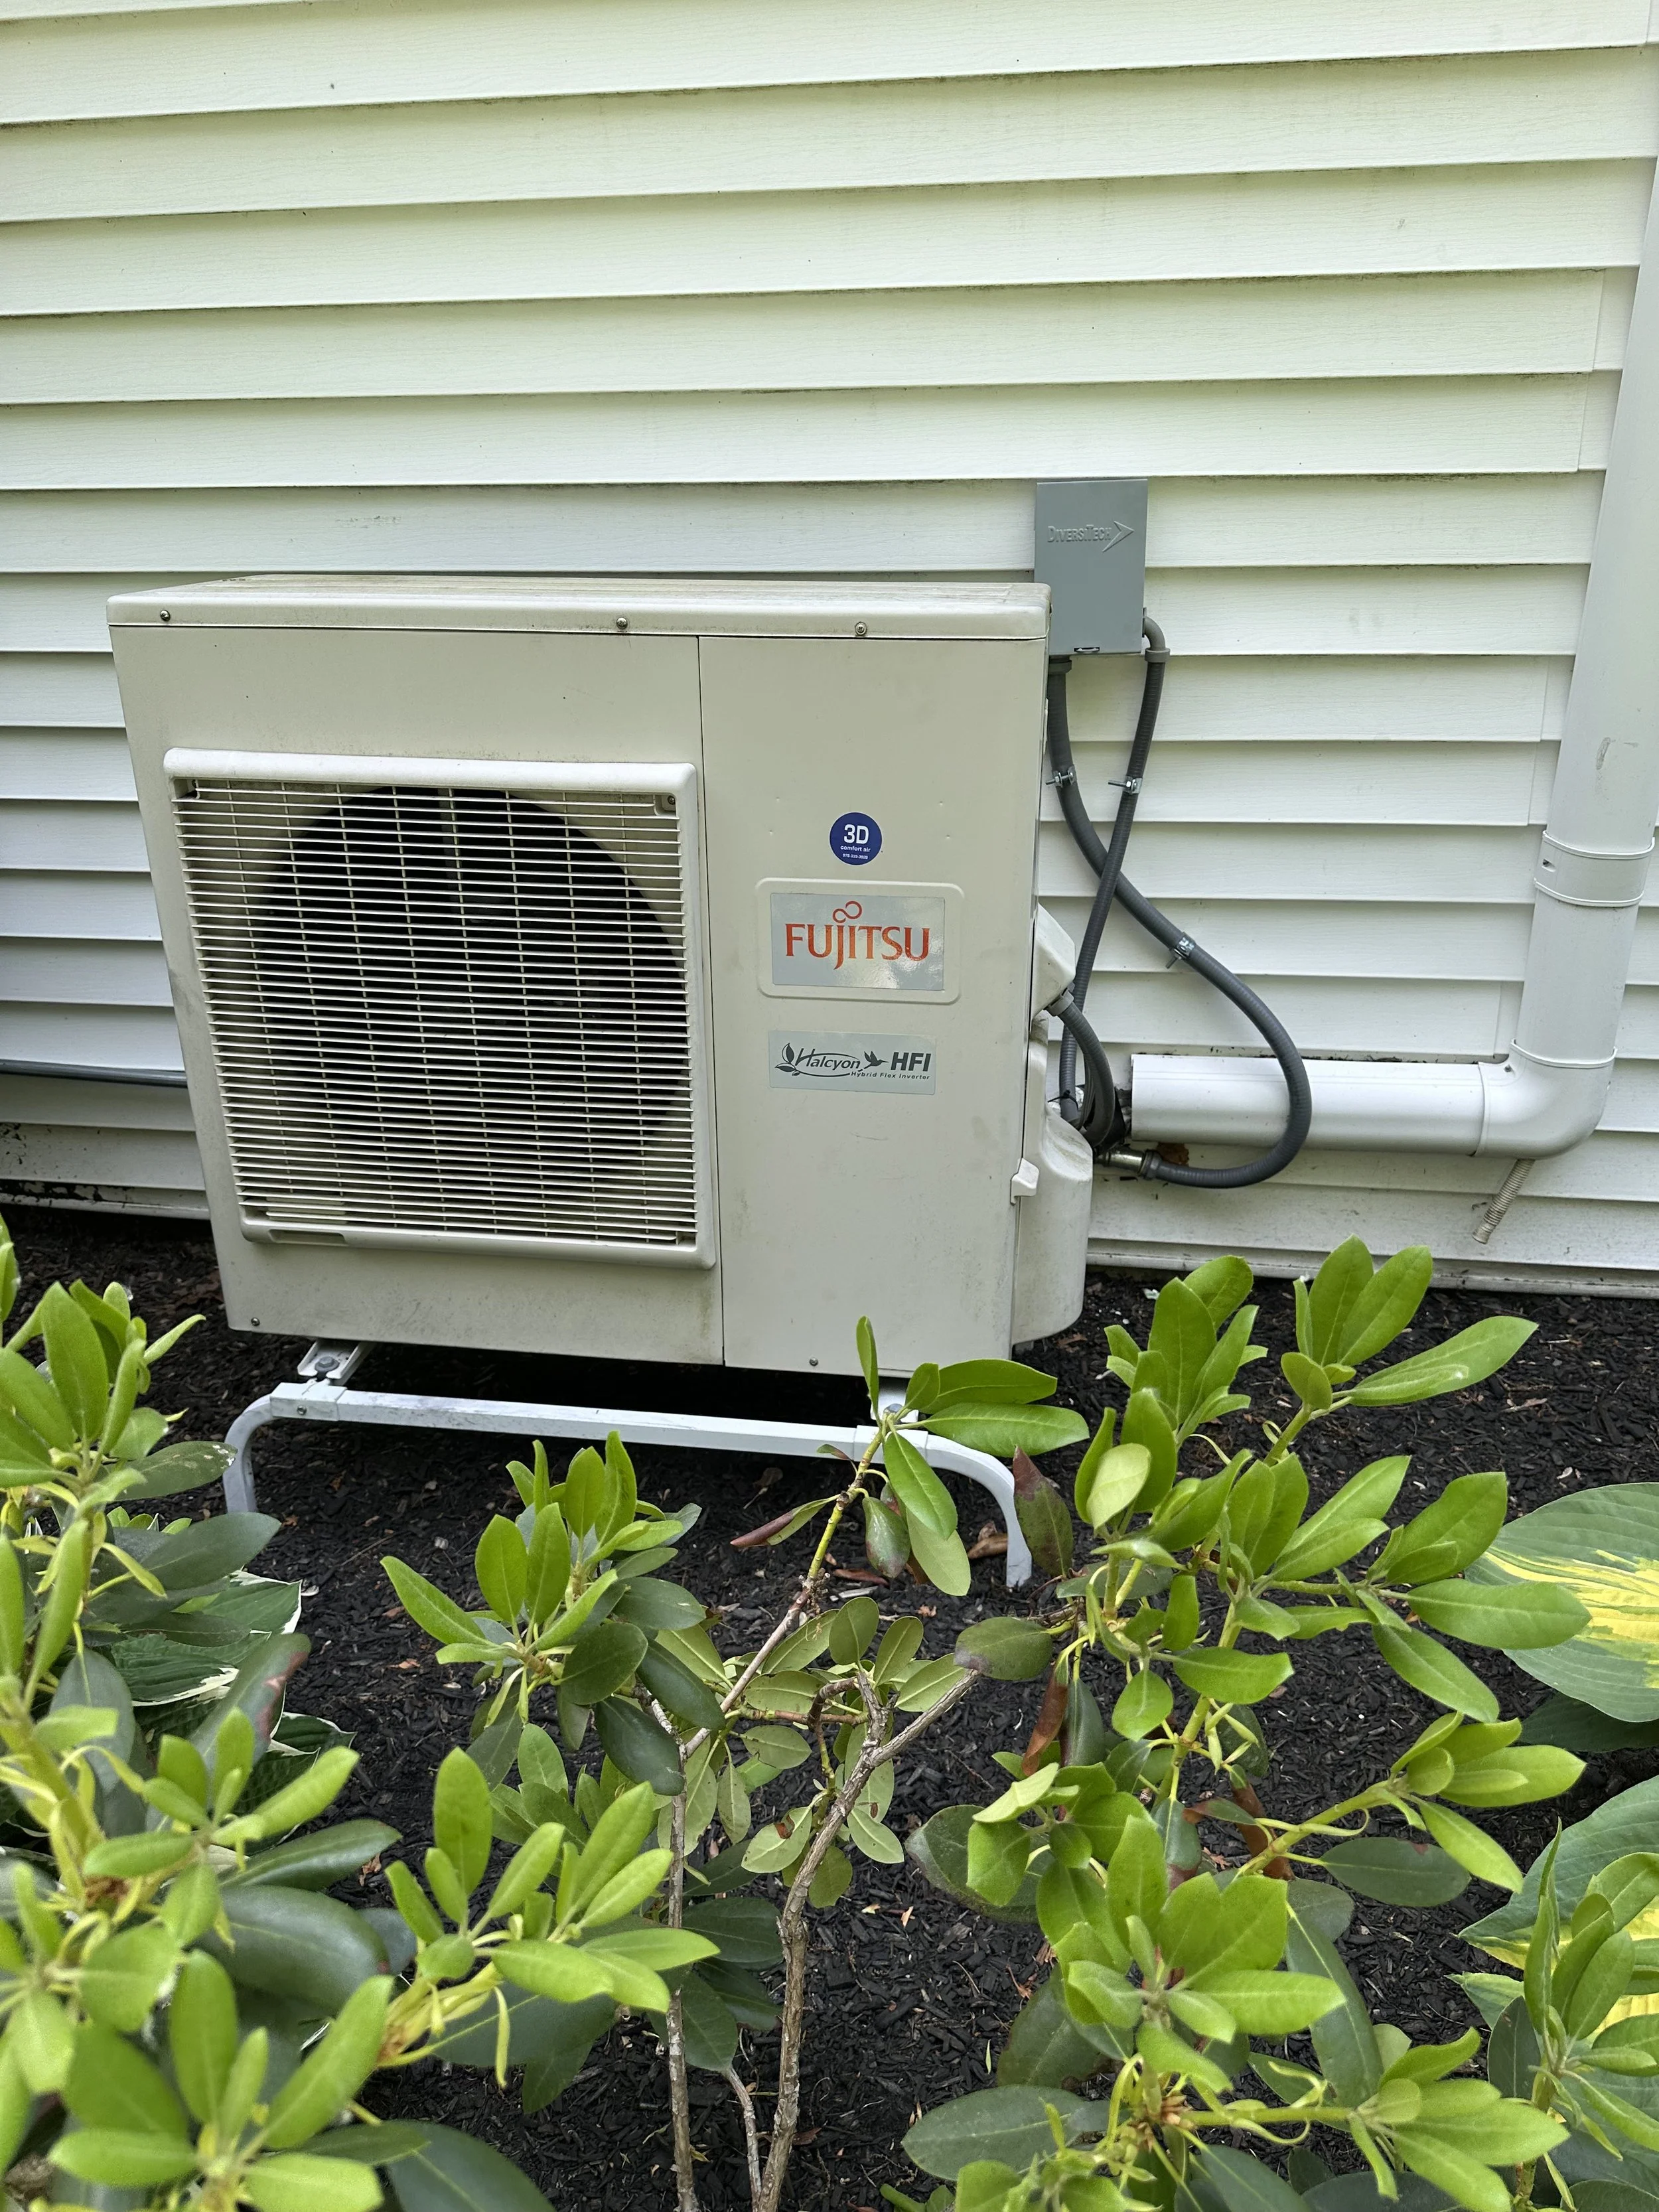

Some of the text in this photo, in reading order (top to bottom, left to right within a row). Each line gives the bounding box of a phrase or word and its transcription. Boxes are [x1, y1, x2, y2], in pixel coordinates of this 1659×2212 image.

[843, 824, 869, 844] 3D
[785, 922, 930, 970] FUJITSU
[795, 1048, 932, 1072] Halcyon HFI
